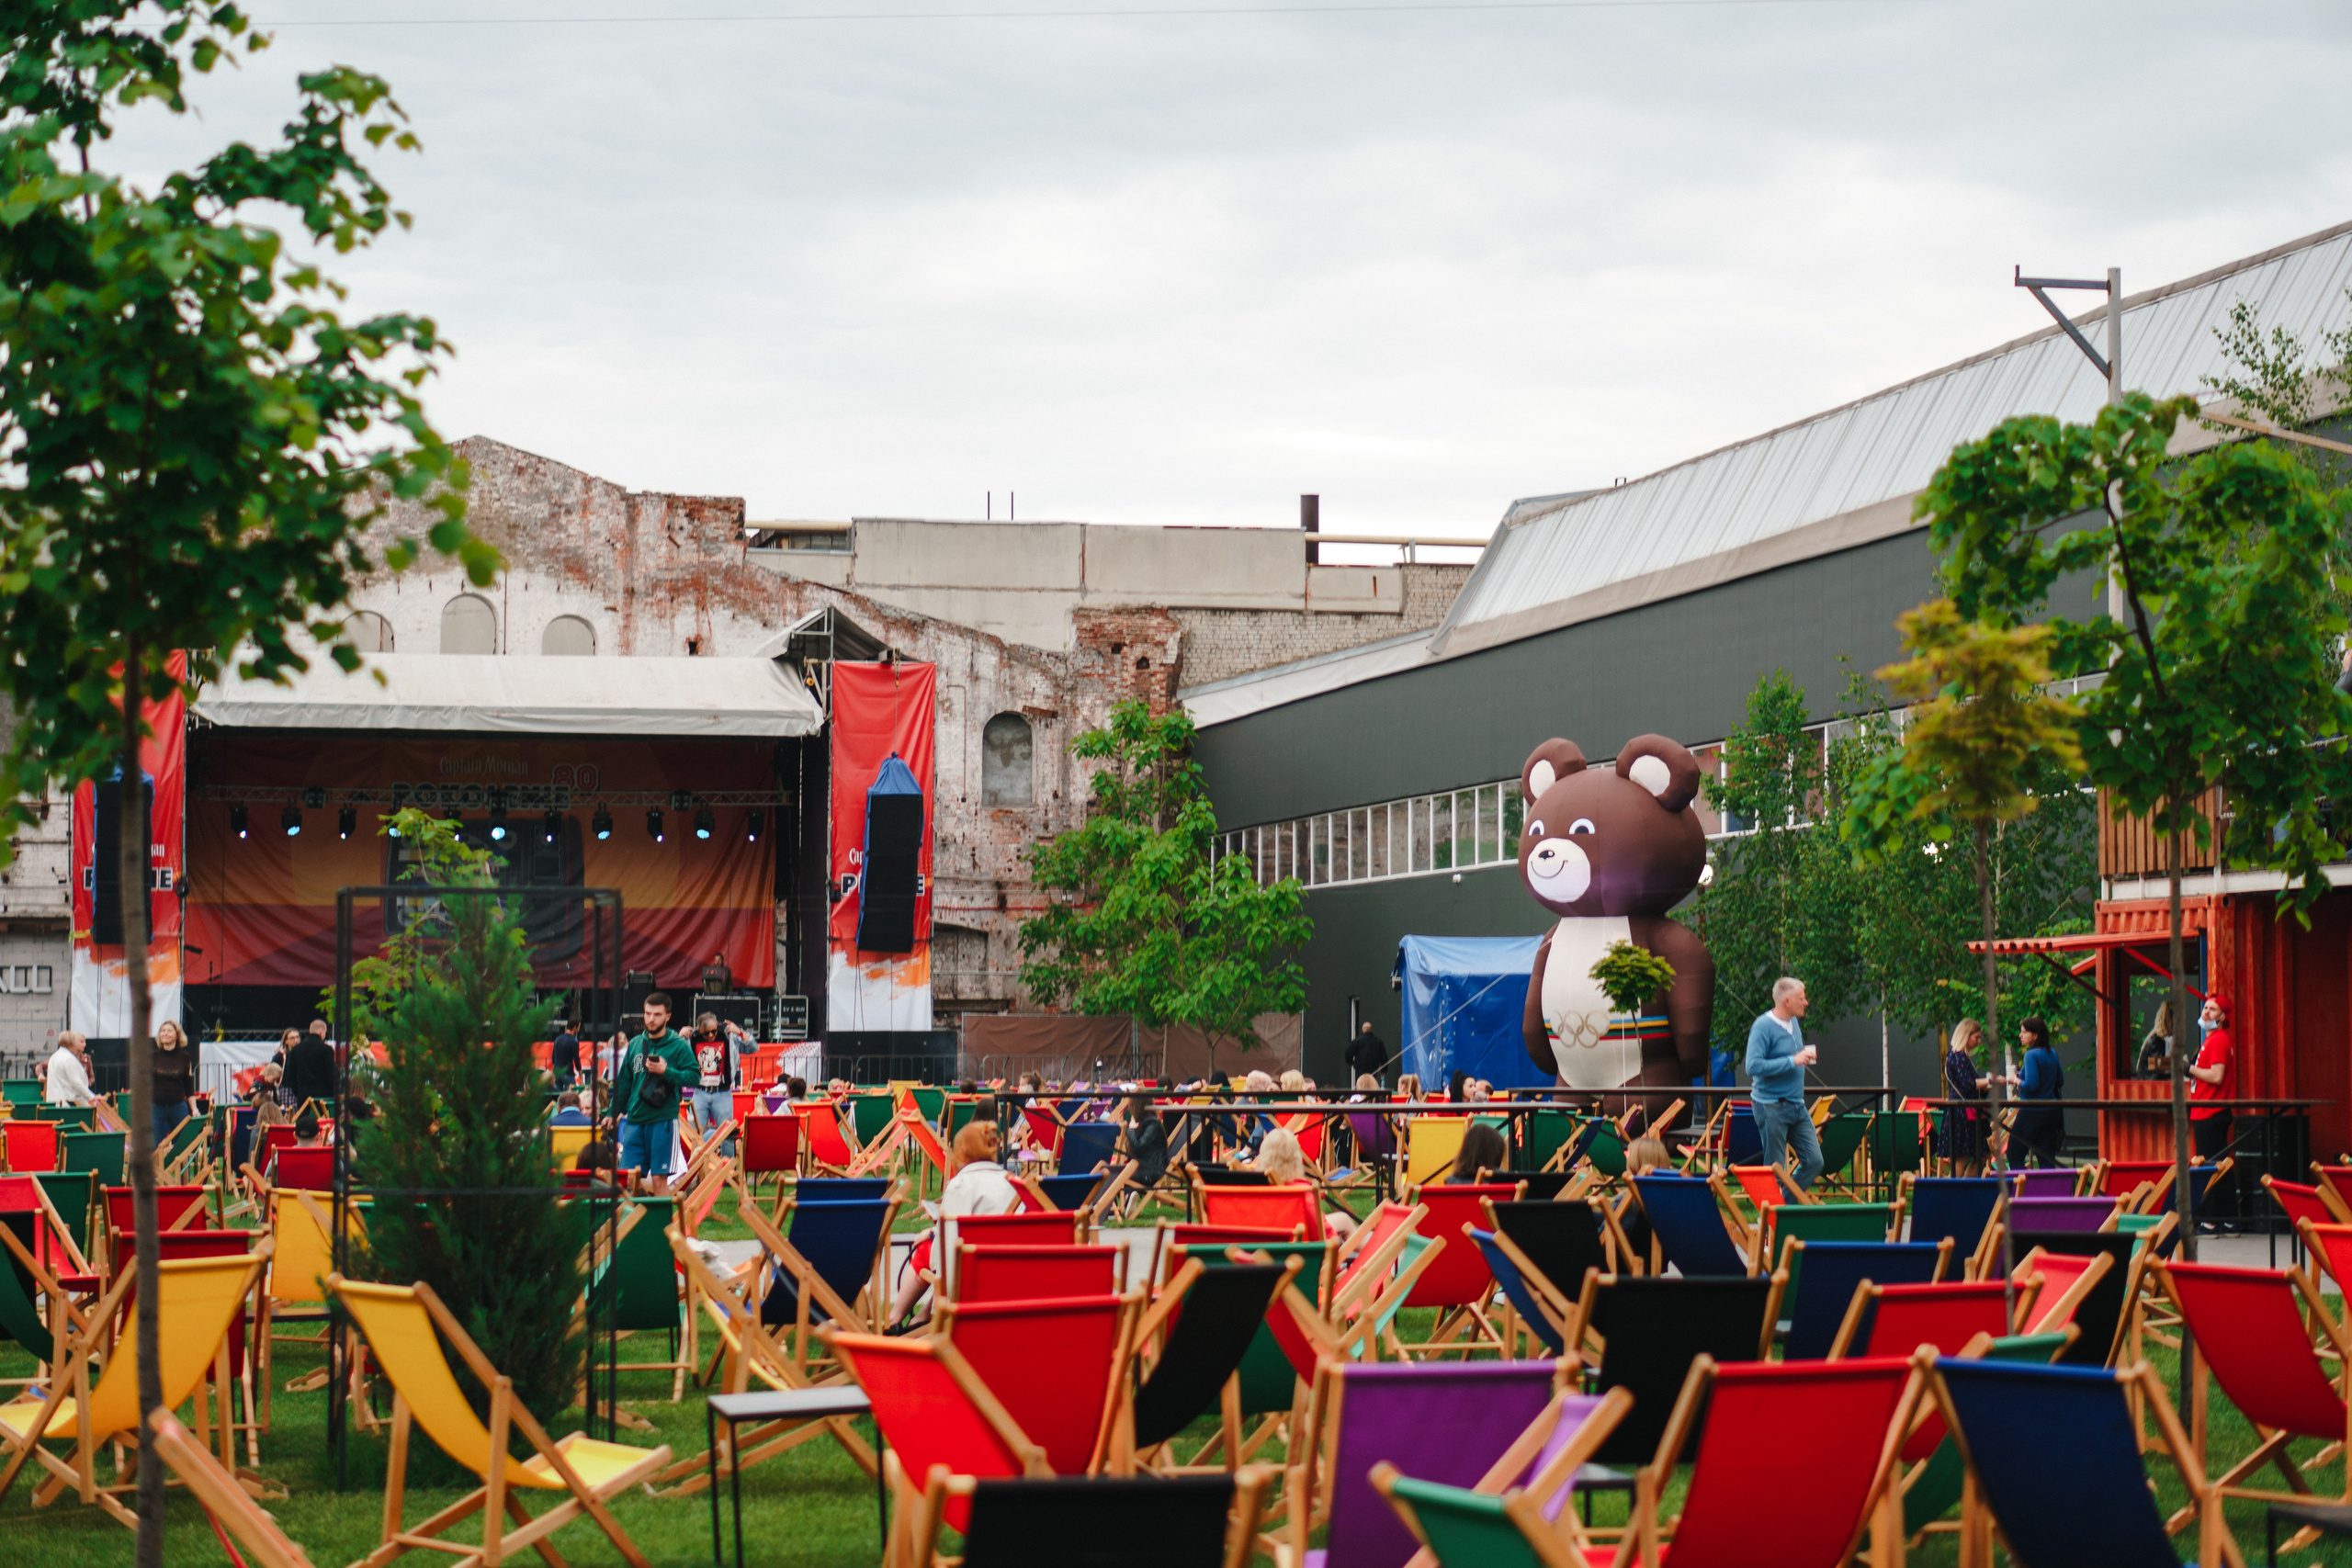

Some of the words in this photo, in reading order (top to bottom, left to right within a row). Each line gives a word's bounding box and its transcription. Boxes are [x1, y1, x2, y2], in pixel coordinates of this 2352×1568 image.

[439, 756, 481, 777] Captain
[481, 754, 528, 777] Morgan
[551, 762, 600, 794] 80
